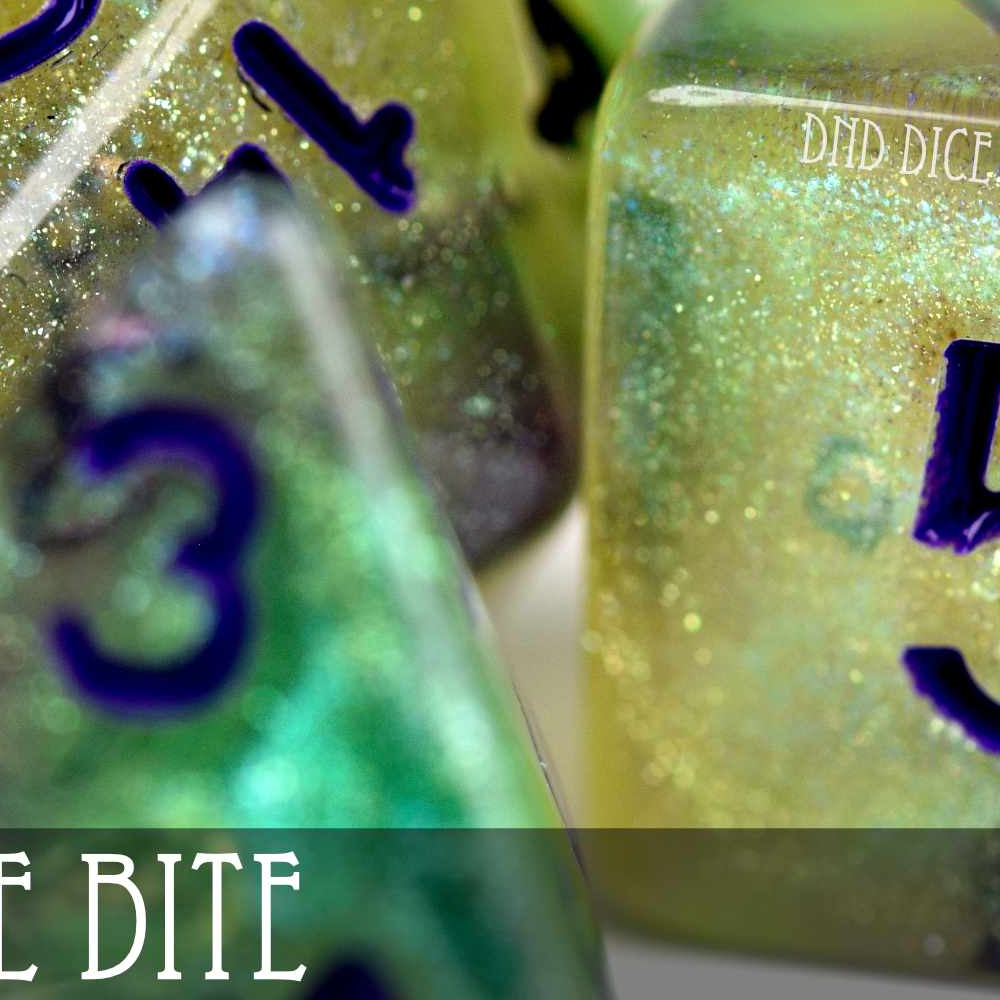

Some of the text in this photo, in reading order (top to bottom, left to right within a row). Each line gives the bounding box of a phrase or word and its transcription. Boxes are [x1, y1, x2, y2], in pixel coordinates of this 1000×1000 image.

[799, 111, 993, 185] DND DICE
[52, 405, 262, 722] 3
